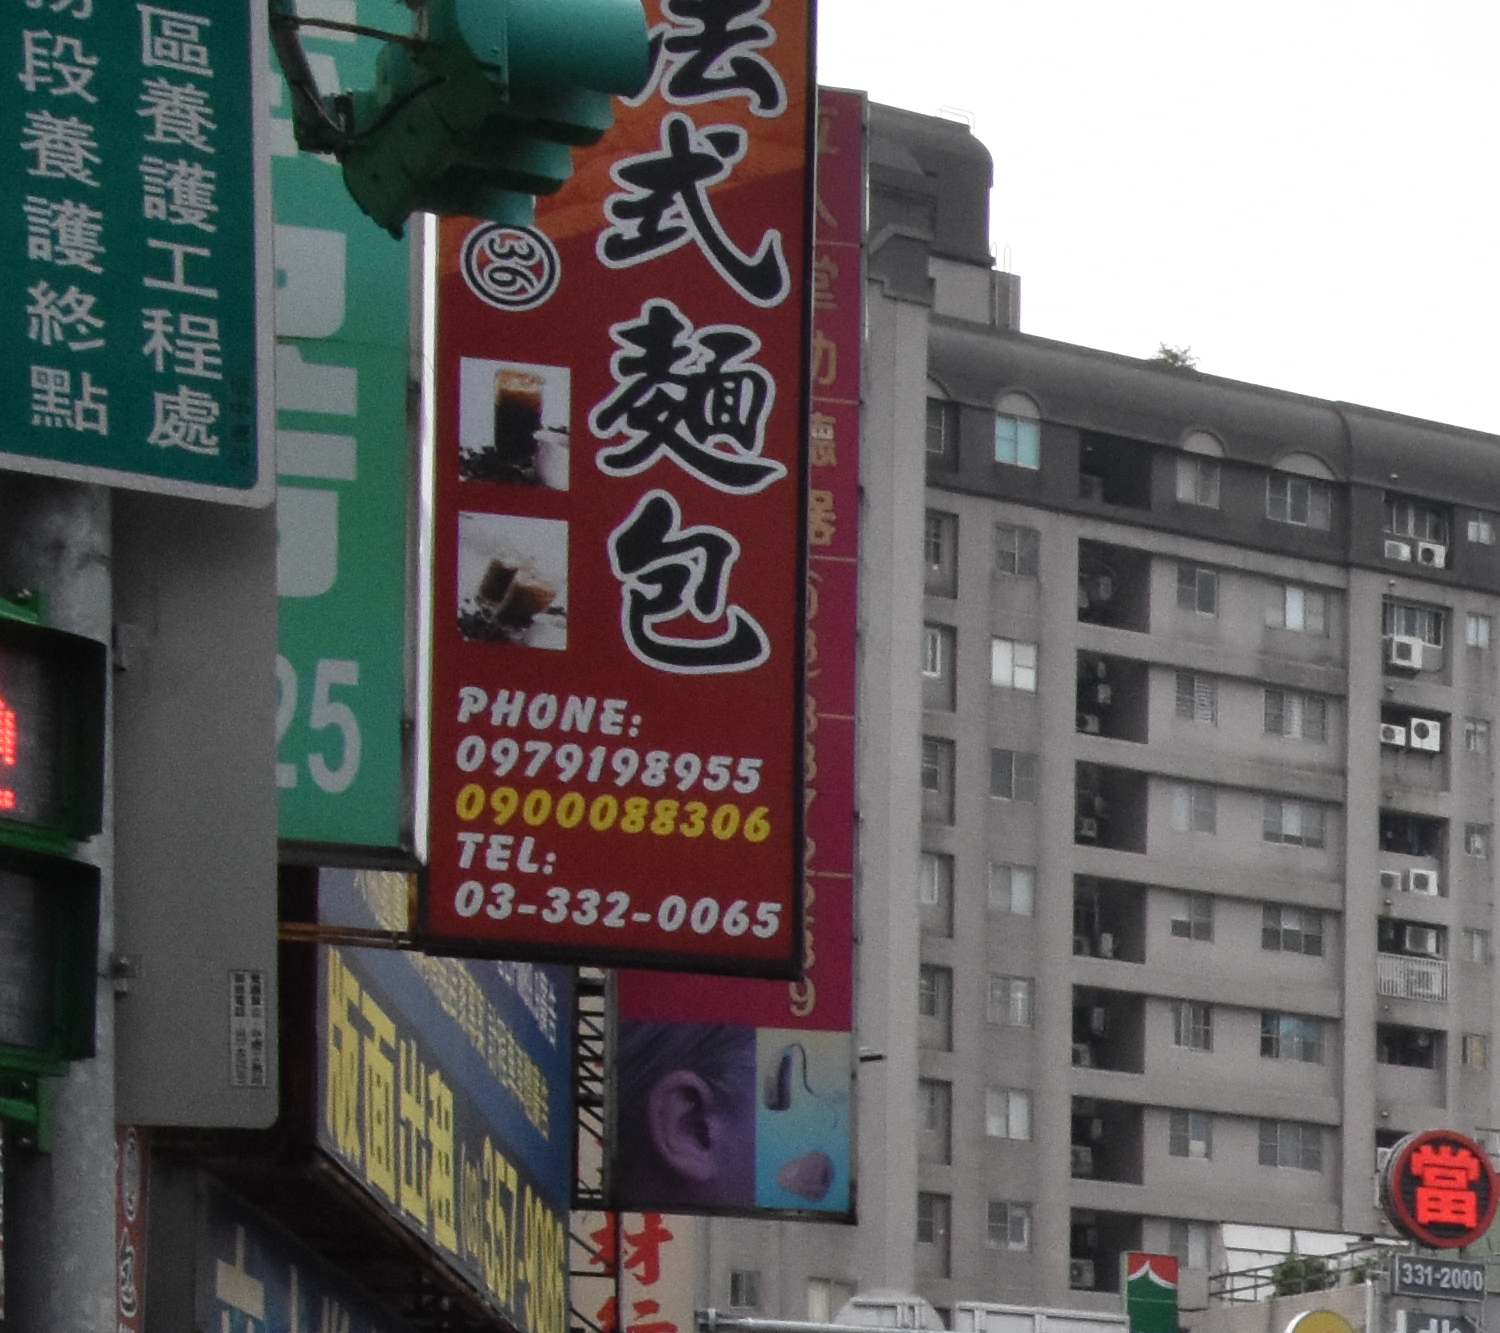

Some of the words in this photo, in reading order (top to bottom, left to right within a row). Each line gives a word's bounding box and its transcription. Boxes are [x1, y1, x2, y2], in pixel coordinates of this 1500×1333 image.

[18, 0, 108, 437] 段養護終點
[136, 3, 224, 456] 區養護工程處
[456, 686, 643, 740] PHONE:
[456, 735, 764, 797] 0979198955
[455, 784, 774, 843] 0900088306
[454, 832, 558, 875] TEL:
[453, 881, 785, 940] 03-332-0065
[1409, 1143, 1482, 1231] 當
[1401, 1262, 1484, 1292] 331-2000
